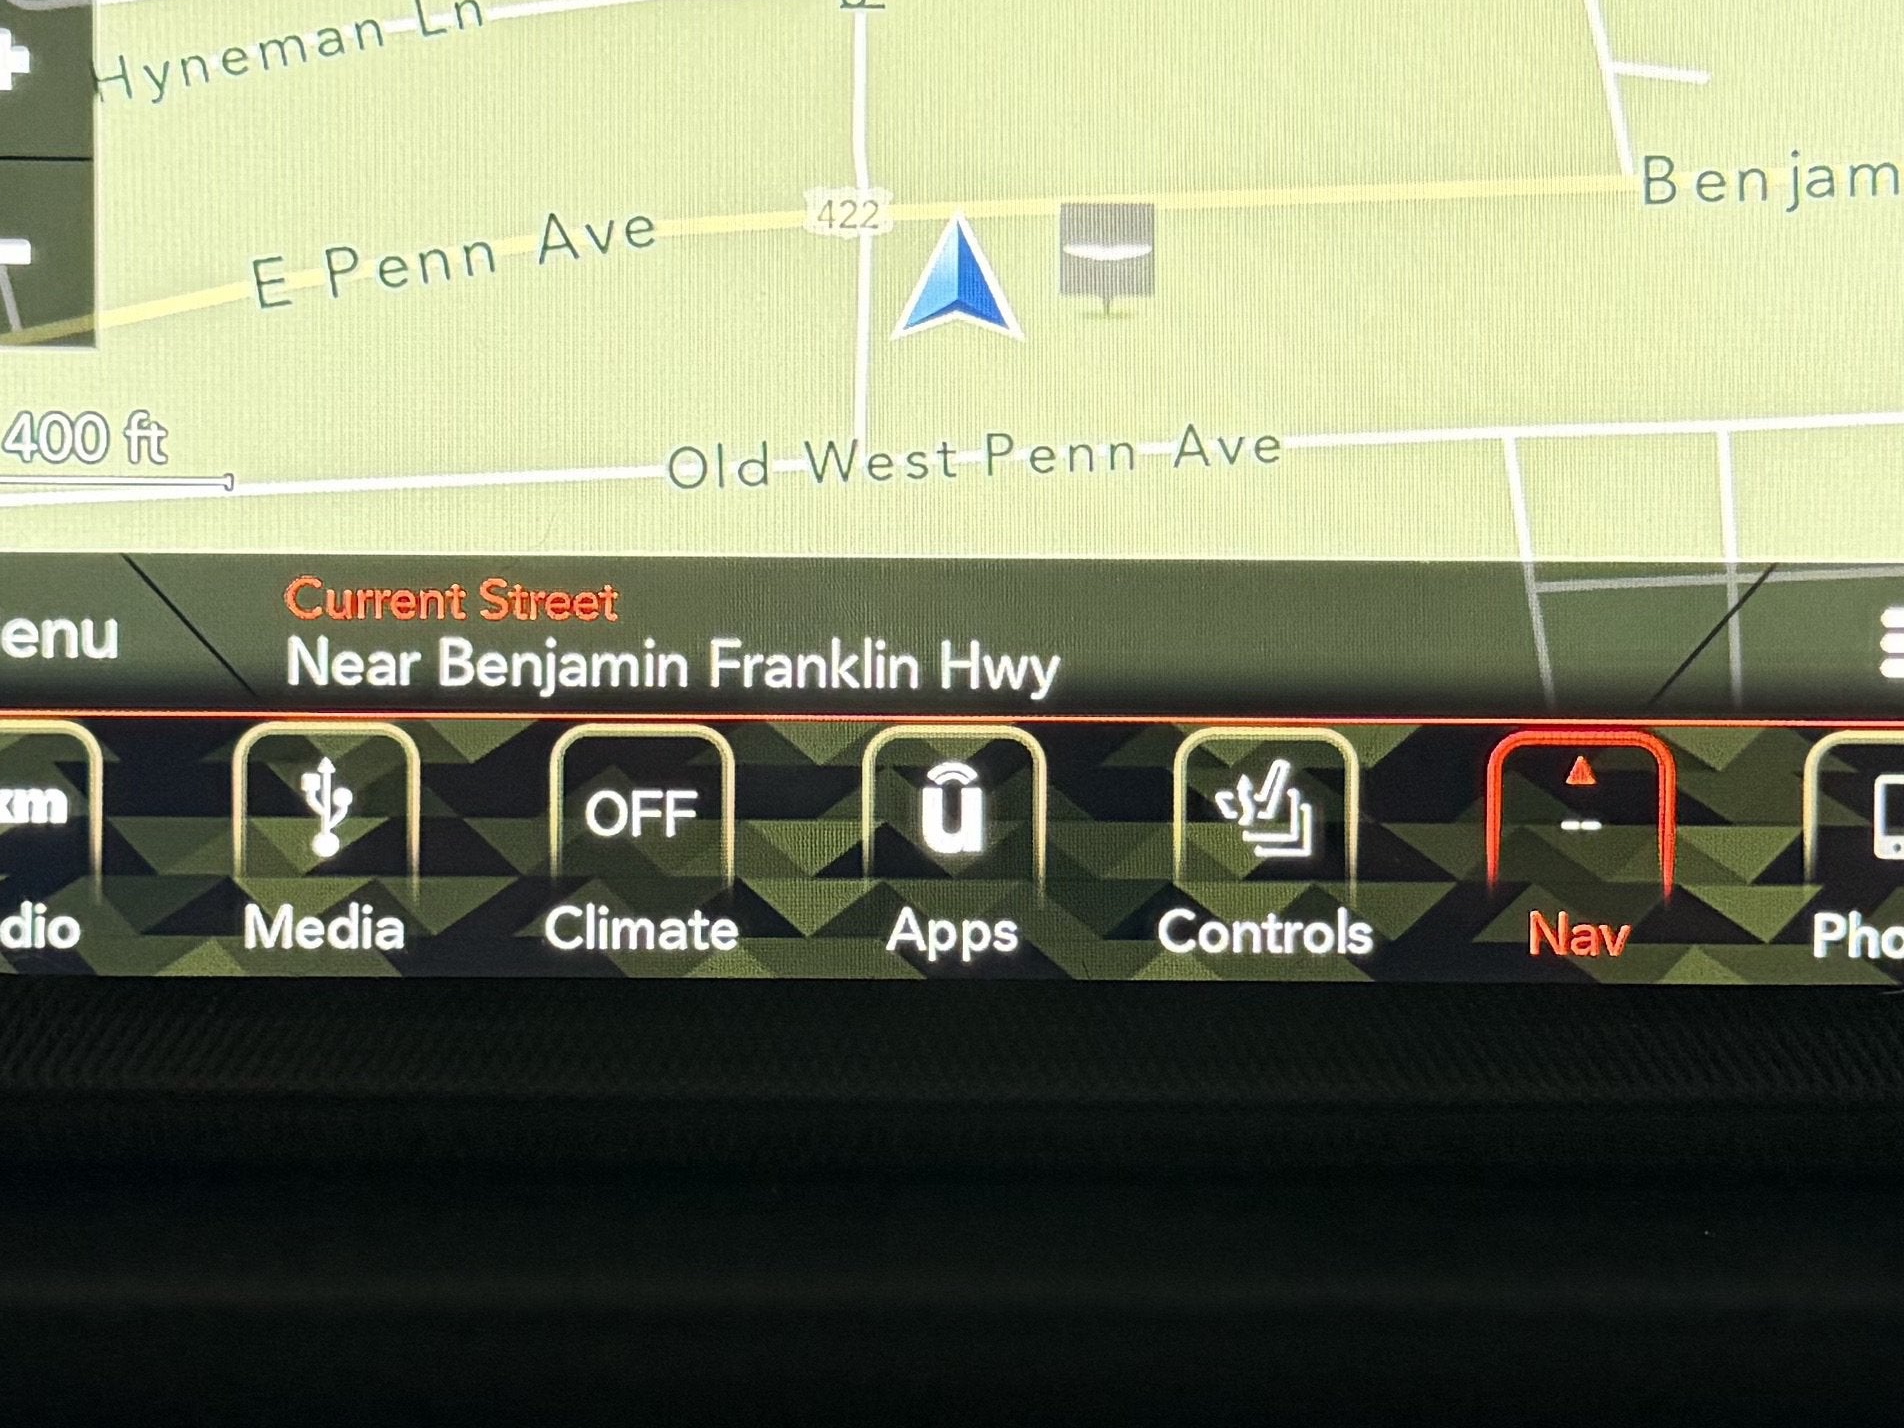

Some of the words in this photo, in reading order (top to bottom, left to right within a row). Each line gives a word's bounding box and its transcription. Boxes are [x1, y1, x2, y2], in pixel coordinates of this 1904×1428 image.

[91, 17, 385, 104] Hyneman
[817, 198, 880, 230] 422
[251, 256, 291, 310] E
[326, 233, 498, 300] Penn
[537, 209, 658, 266] Ave
[1, 410, 109, 465] 400
[123, 409, 169, 466] ft
[668, 441, 768, 490] Old
[804, 438, 958, 484] West
[986, 433, 1136, 477] Penn
[1174, 423, 1283, 469] Ave
[283, 576, 468, 622] Current
[479, 577, 620, 623] Street
[286, 636, 421, 690] Near
[439, 637, 688, 703] Benjamin
[710, 639, 920, 693] Franklin
[941, 641, 1062, 701] Hwy
[584, 789, 698, 839] OFF
[244, 904, 406, 953] Media
[545, 905, 740, 954] Climate
[885, 906, 1019, 963] Apps
[1158, 908, 1374, 957] Controls
[1528, 910, 1631, 957] Nav
